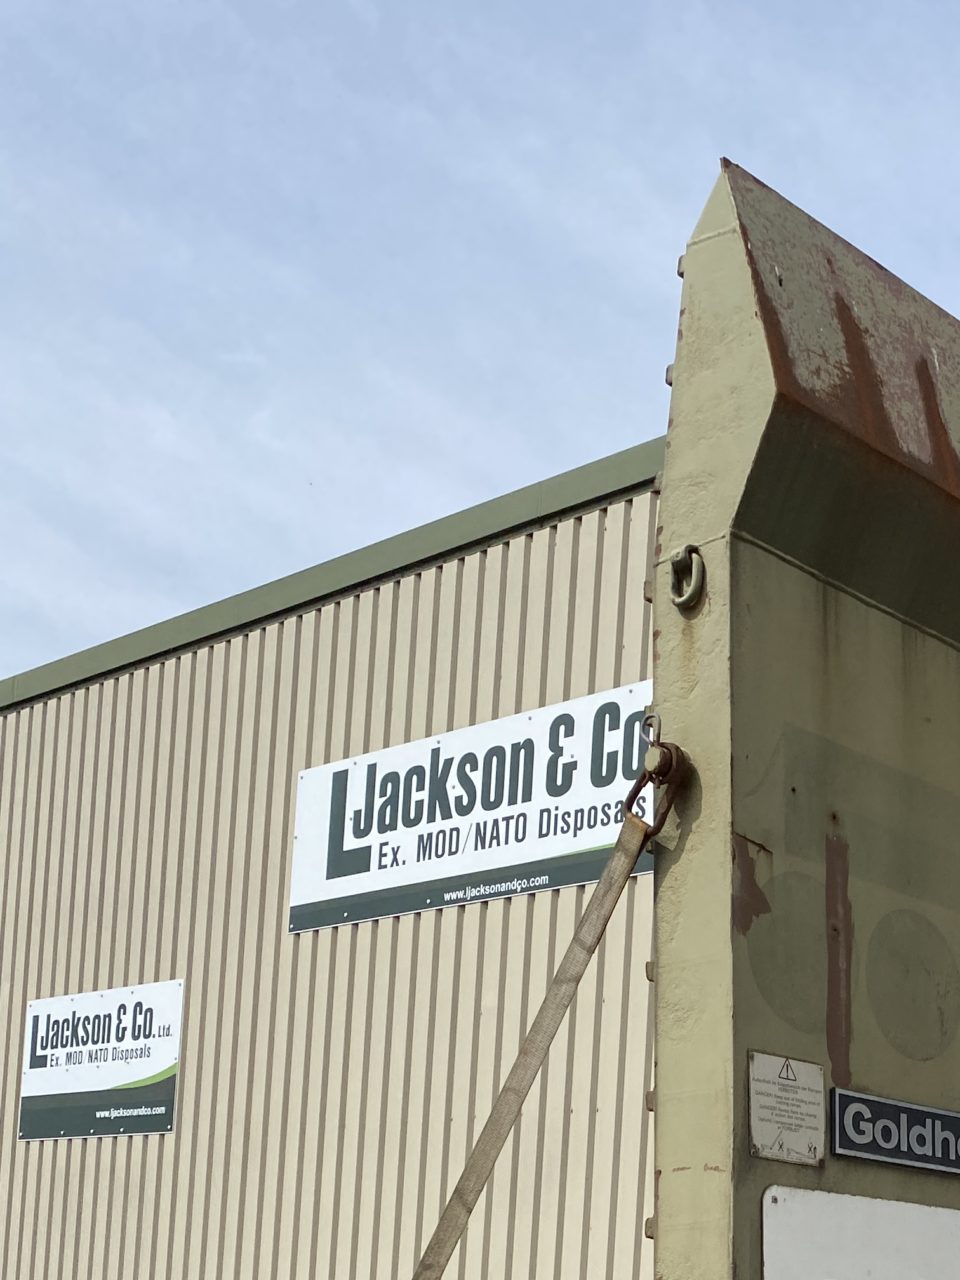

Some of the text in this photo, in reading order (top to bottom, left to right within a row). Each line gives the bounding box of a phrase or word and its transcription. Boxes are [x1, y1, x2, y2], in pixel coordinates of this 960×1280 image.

[546, 713, 577, 798] &
[377, 796, 647, 870] Ex. MOD/NATO Disposas
[444, 875, 549, 901] www.ljacksonandco.com
[115, 1003, 127, 1042] &
[158, 1024, 173, 1038] Ltd.
[50, 1044, 151, 1068] Ex. MOD/NATO Disposals
